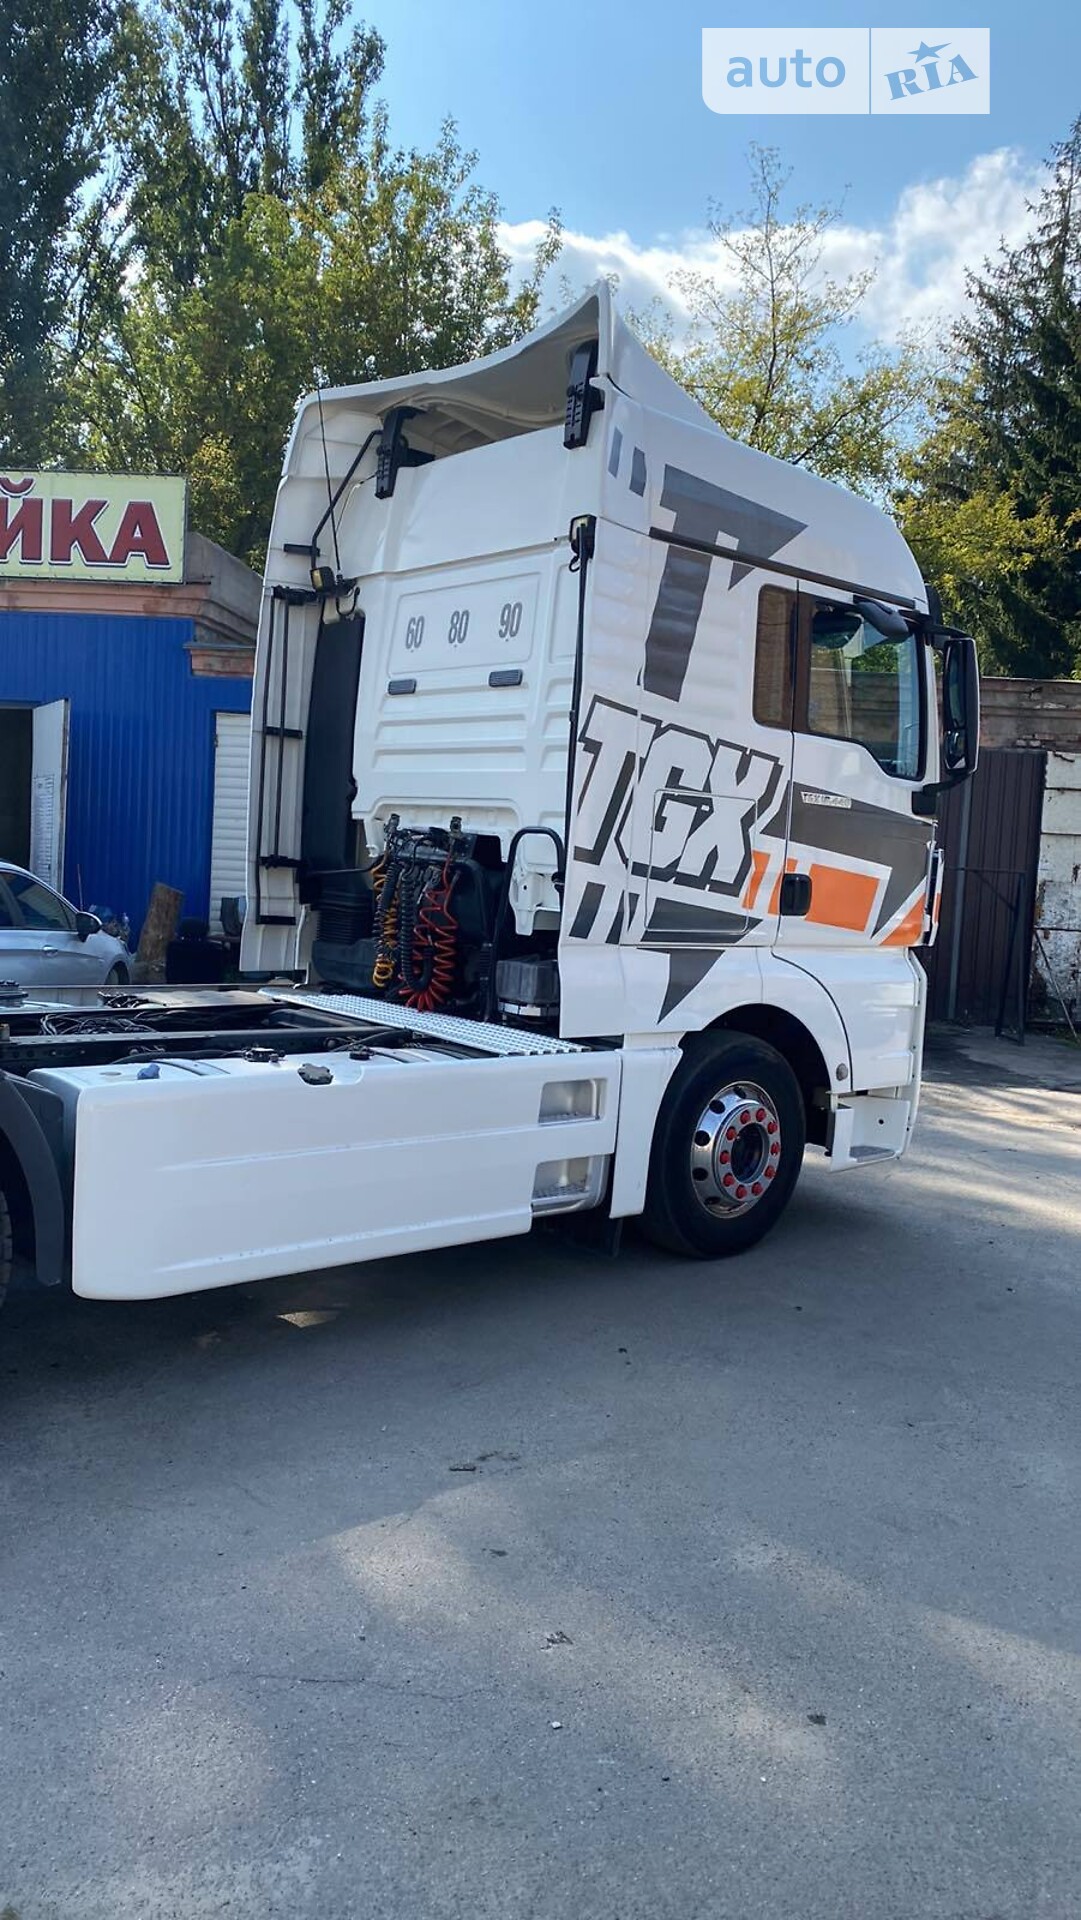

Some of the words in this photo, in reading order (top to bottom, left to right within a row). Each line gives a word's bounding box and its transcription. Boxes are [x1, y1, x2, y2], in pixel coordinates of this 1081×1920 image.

[405, 615, 425, 650] 60
[448, 610, 470, 644] 80
[499, 601, 523, 638] 90
[573, 694, 784, 898] TGX
